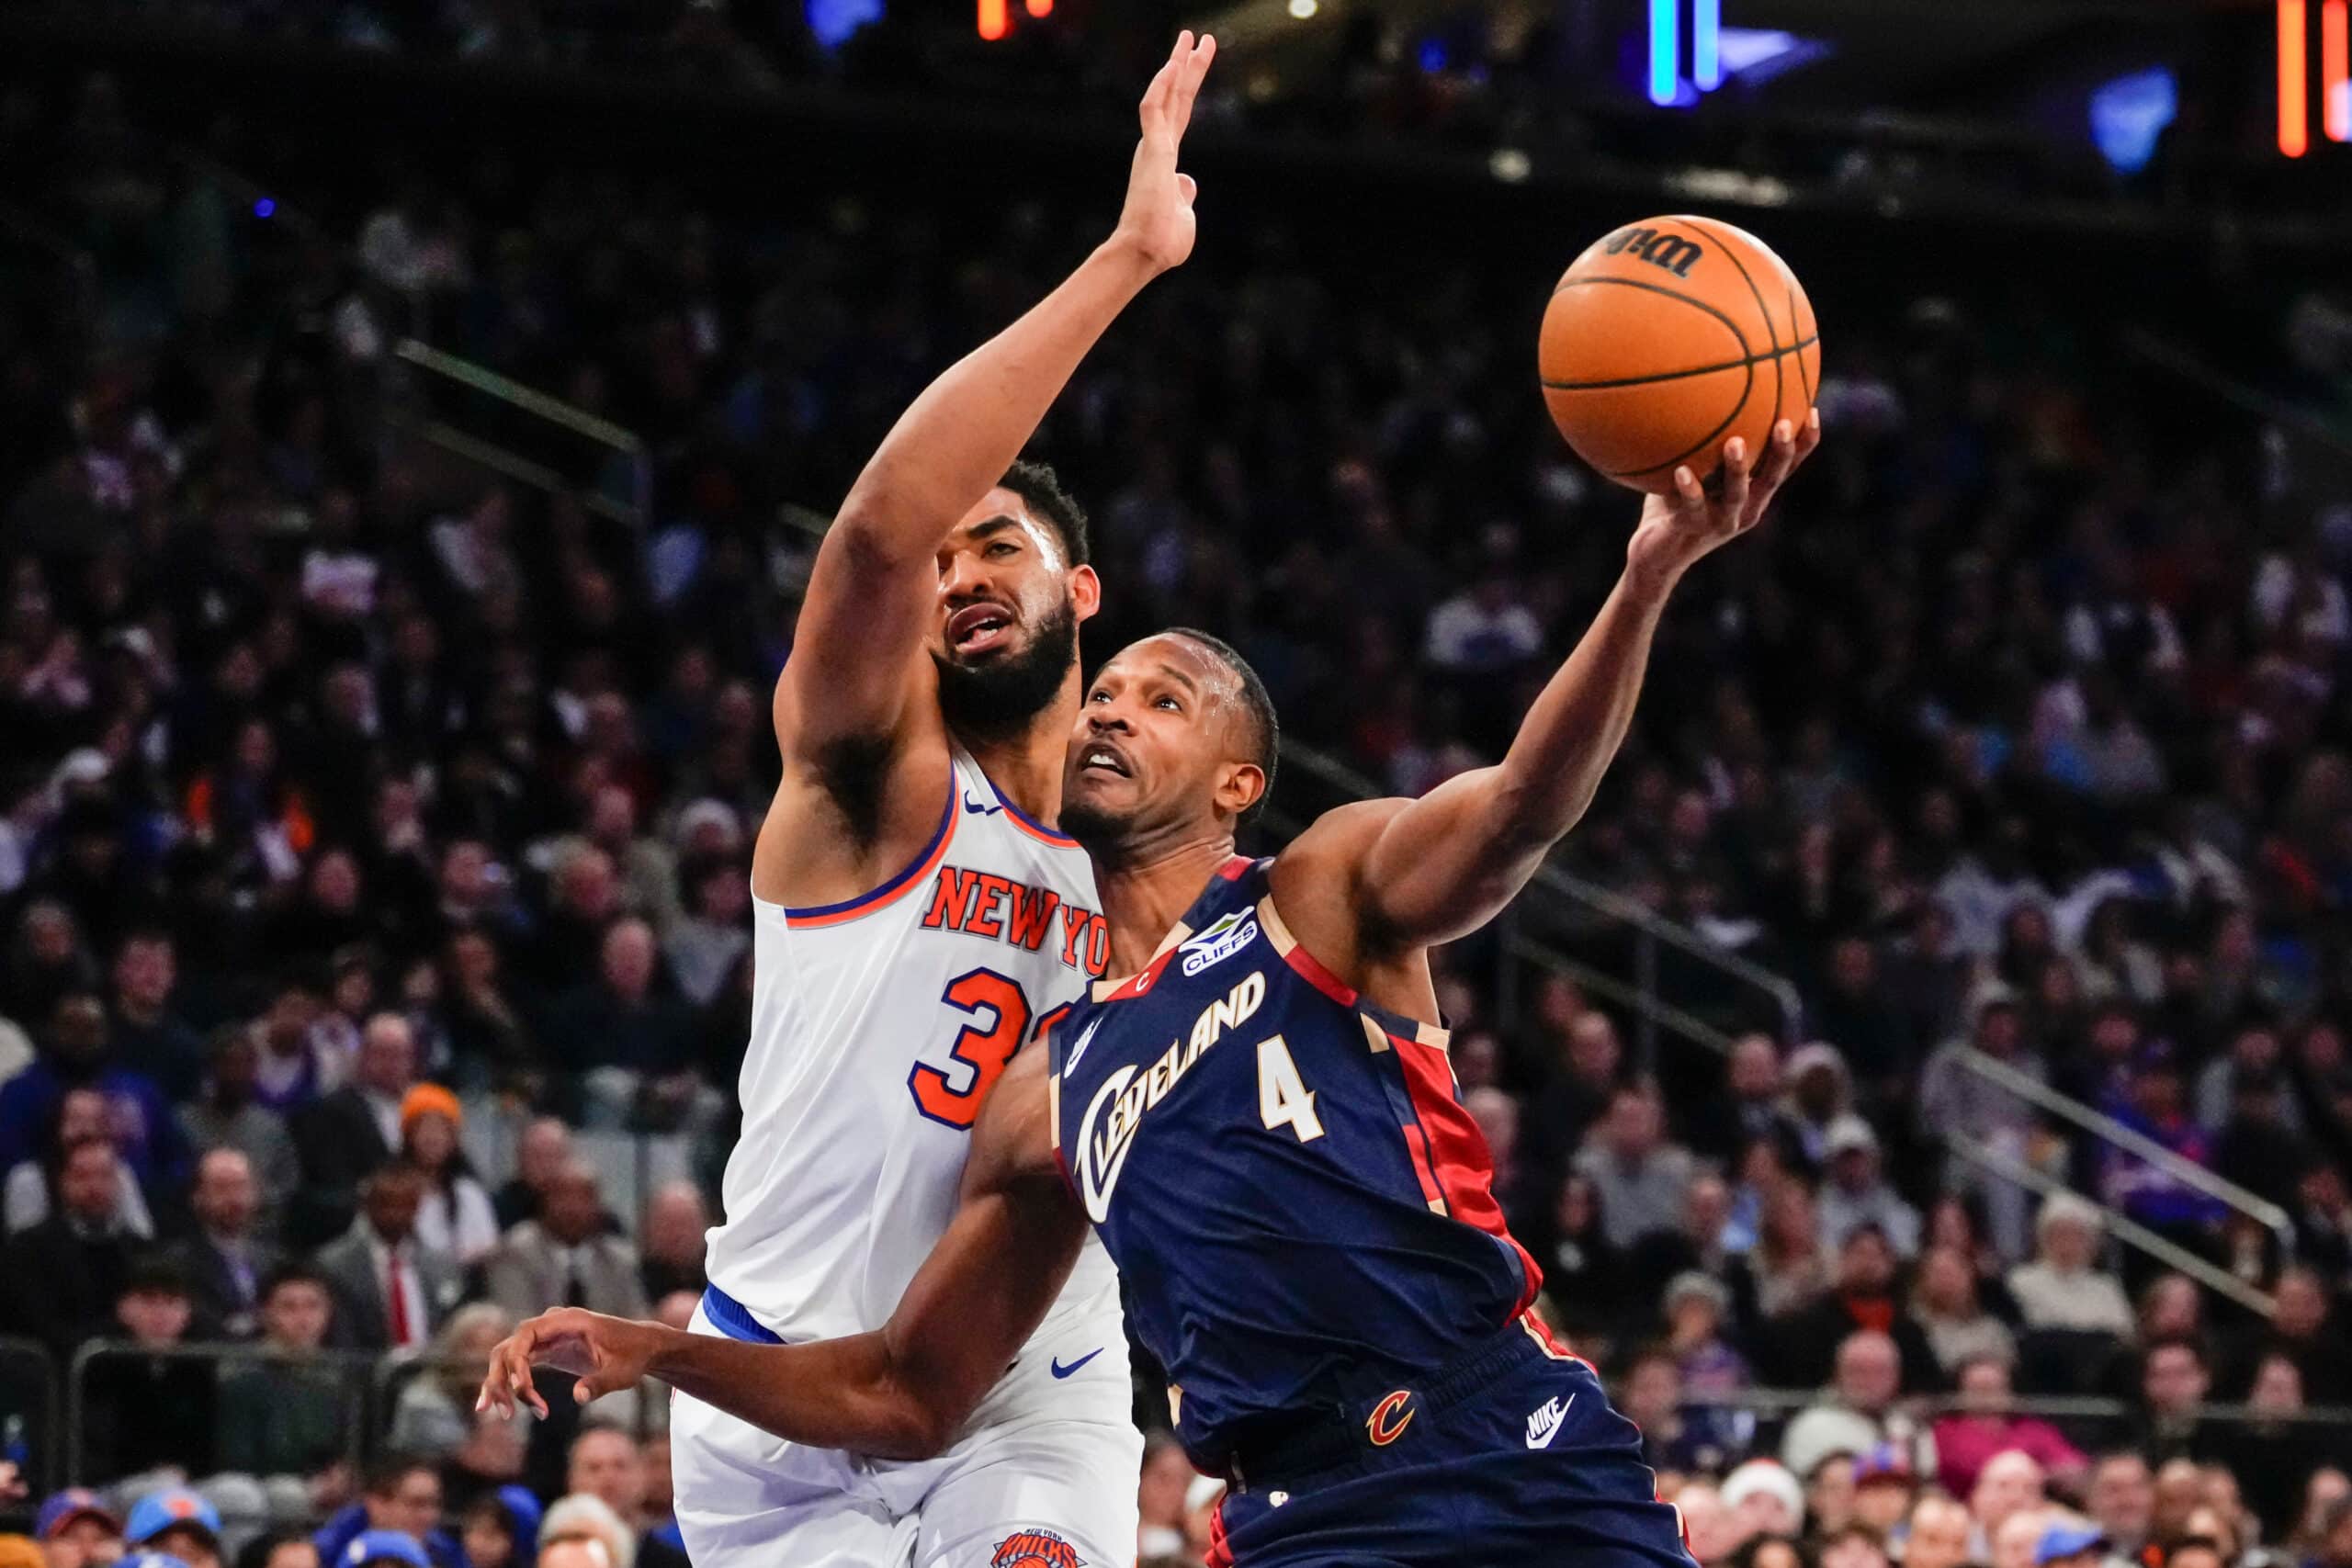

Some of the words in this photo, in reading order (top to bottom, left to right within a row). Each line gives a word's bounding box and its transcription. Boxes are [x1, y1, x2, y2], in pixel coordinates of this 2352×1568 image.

[921, 866, 1059, 952] NEW
[1057, 903, 1110, 976] YO
[1185, 924, 1255, 972] CLIFFS
[908, 966, 1071, 1132] 3
[1257, 1033, 1325, 1144] 4
[1073, 970, 1267, 1223] CLEVELAND
[1366, 1389, 1415, 1446] C
[1527, 1395, 1560, 1438] NIKE
[990, 1532, 1078, 1568] KNICKS
